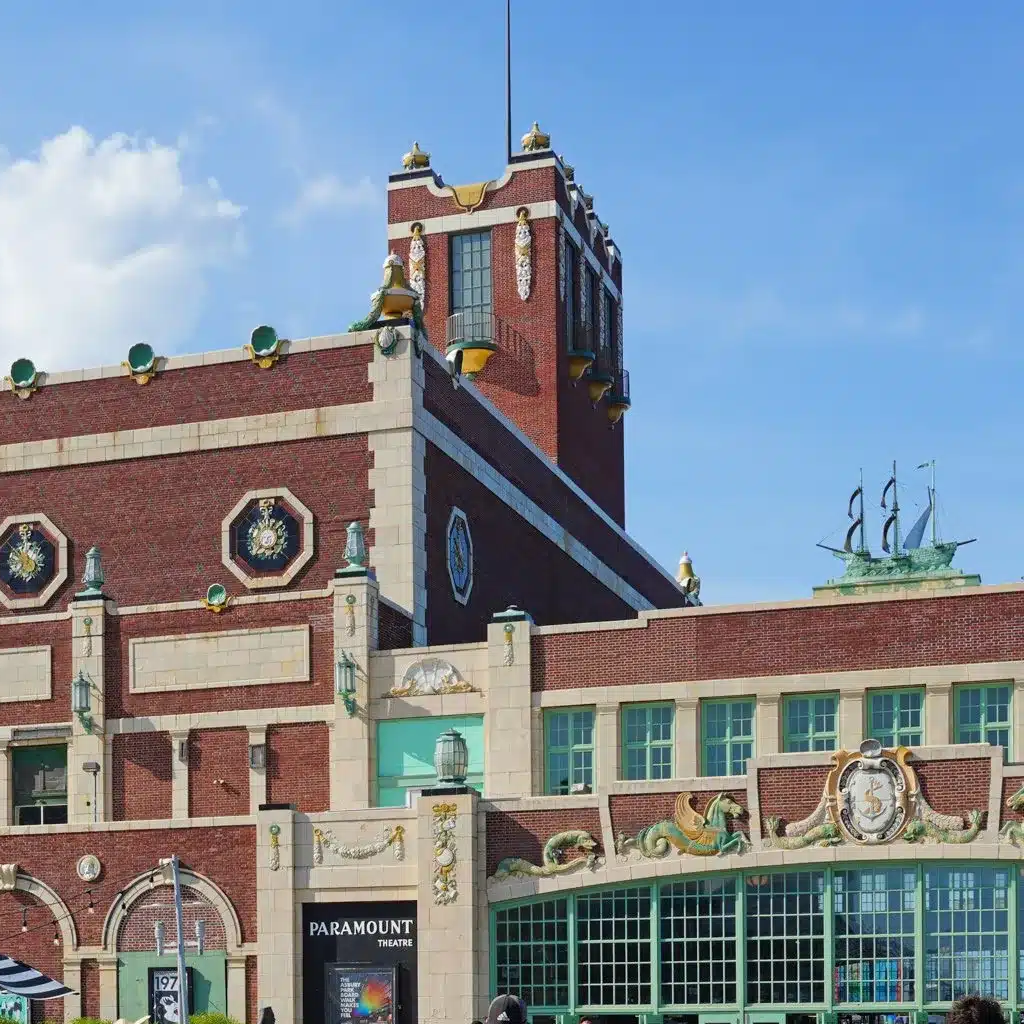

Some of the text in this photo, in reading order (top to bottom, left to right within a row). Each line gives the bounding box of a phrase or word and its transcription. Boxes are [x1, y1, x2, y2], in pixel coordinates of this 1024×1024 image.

[309, 919, 413, 936] PARAMOUNT
[377, 938, 413, 947] THEATRE
[154, 976, 178, 990] 197
